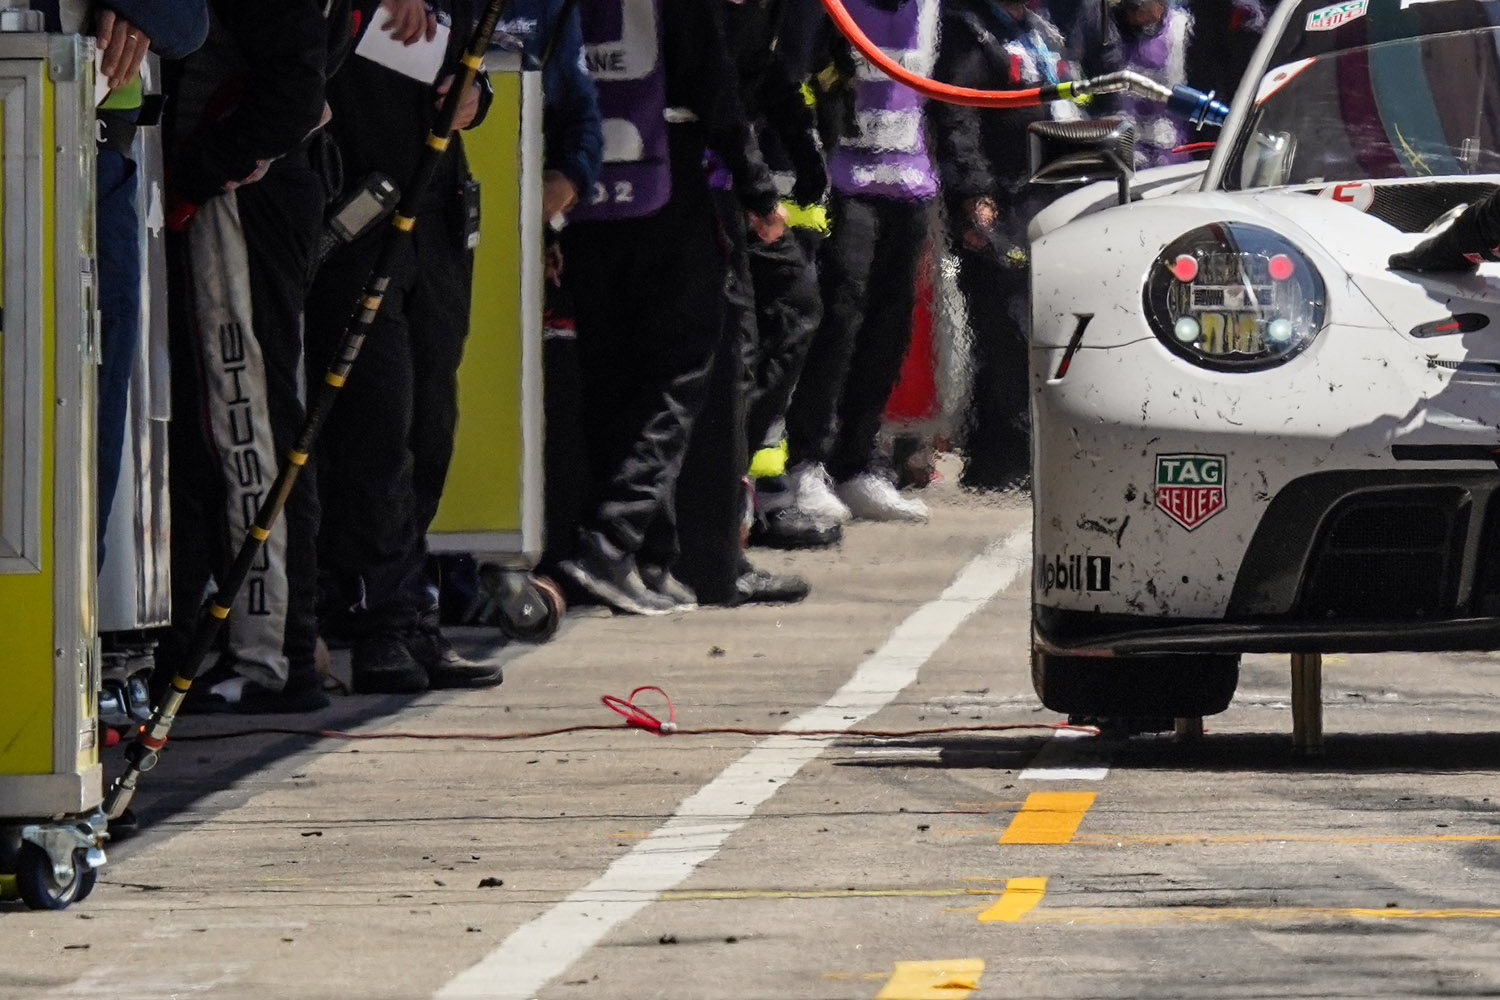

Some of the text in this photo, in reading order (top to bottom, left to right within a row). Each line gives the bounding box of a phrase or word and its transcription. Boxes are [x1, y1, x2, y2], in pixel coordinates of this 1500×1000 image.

[1313, 1, 1364, 20] TAG
[1161, 460, 1220, 484] TAG
[1158, 488, 1222, 528] HEUER
[1089, 557, 1109, 591] 1
